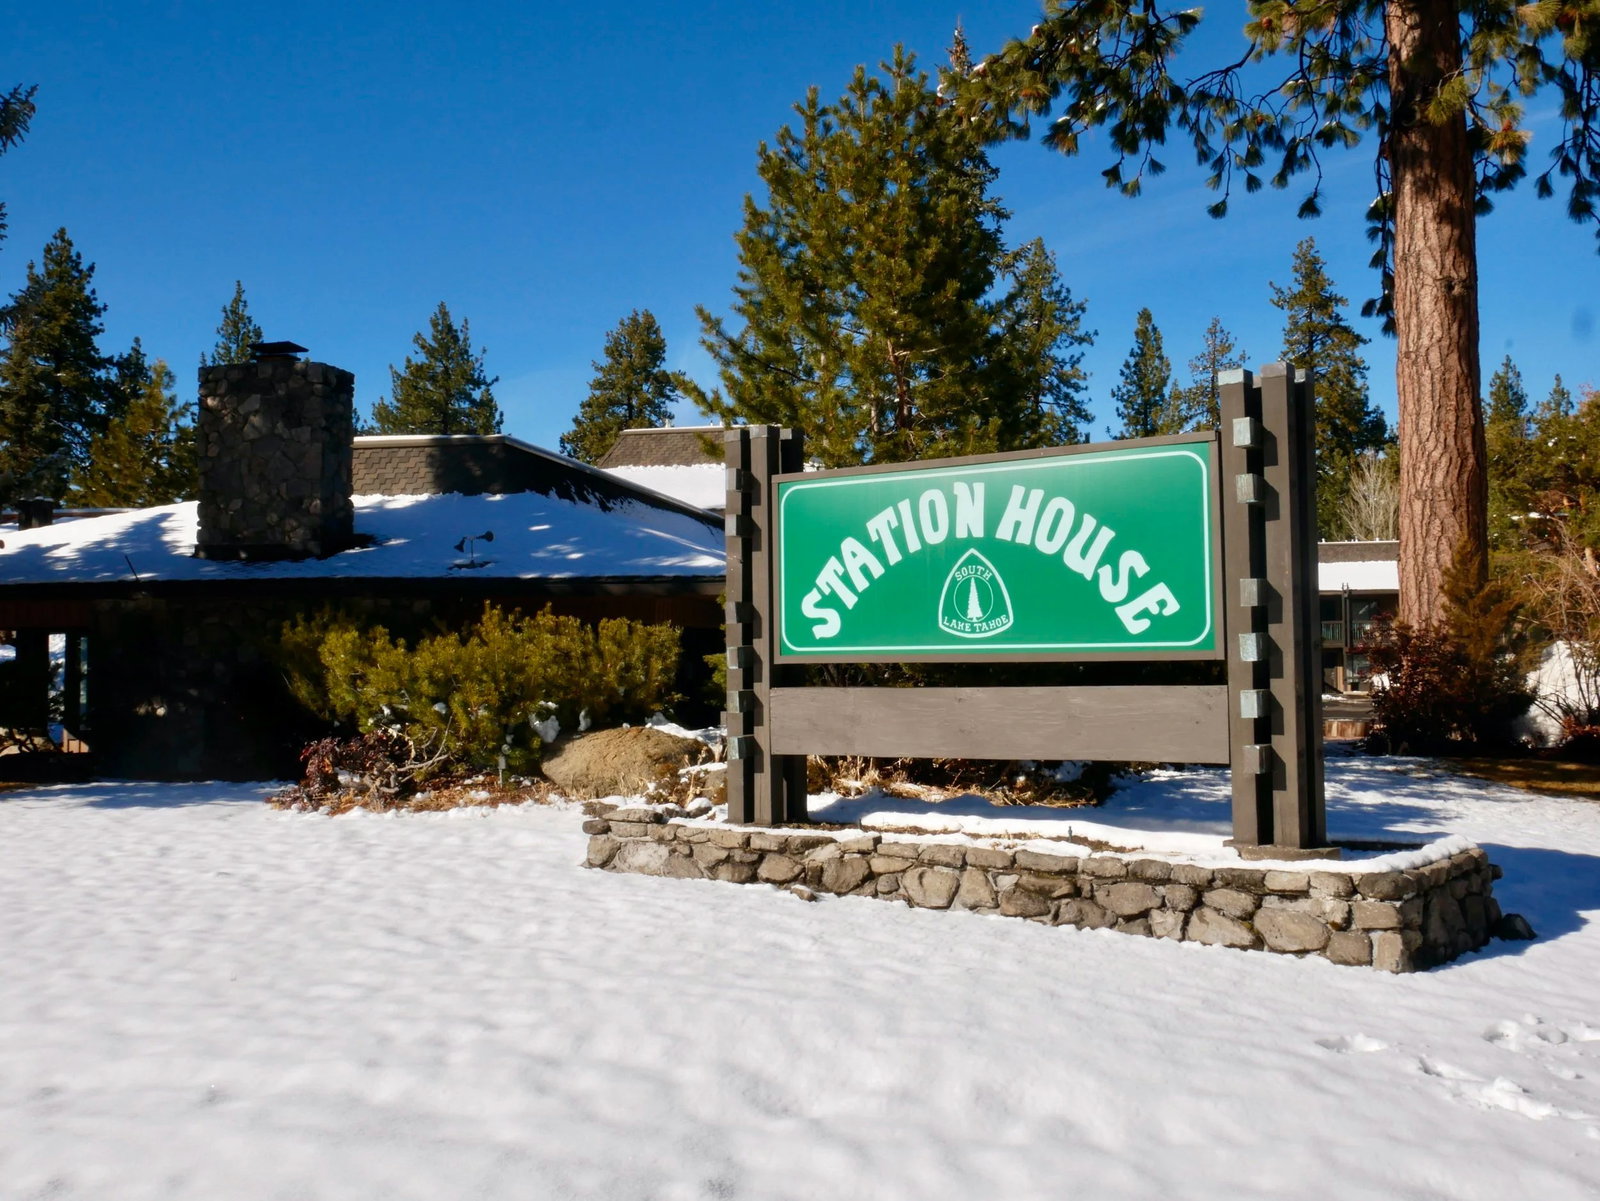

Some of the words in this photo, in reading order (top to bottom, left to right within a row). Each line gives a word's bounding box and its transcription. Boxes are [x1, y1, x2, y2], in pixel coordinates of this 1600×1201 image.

[801, 481, 986, 640] STATION
[995, 484, 1181, 635] HOUSE
[954, 565, 993, 581] SOUTH
[943, 616, 971, 632] LAKE
[974, 614, 1009, 632] TAHOE
